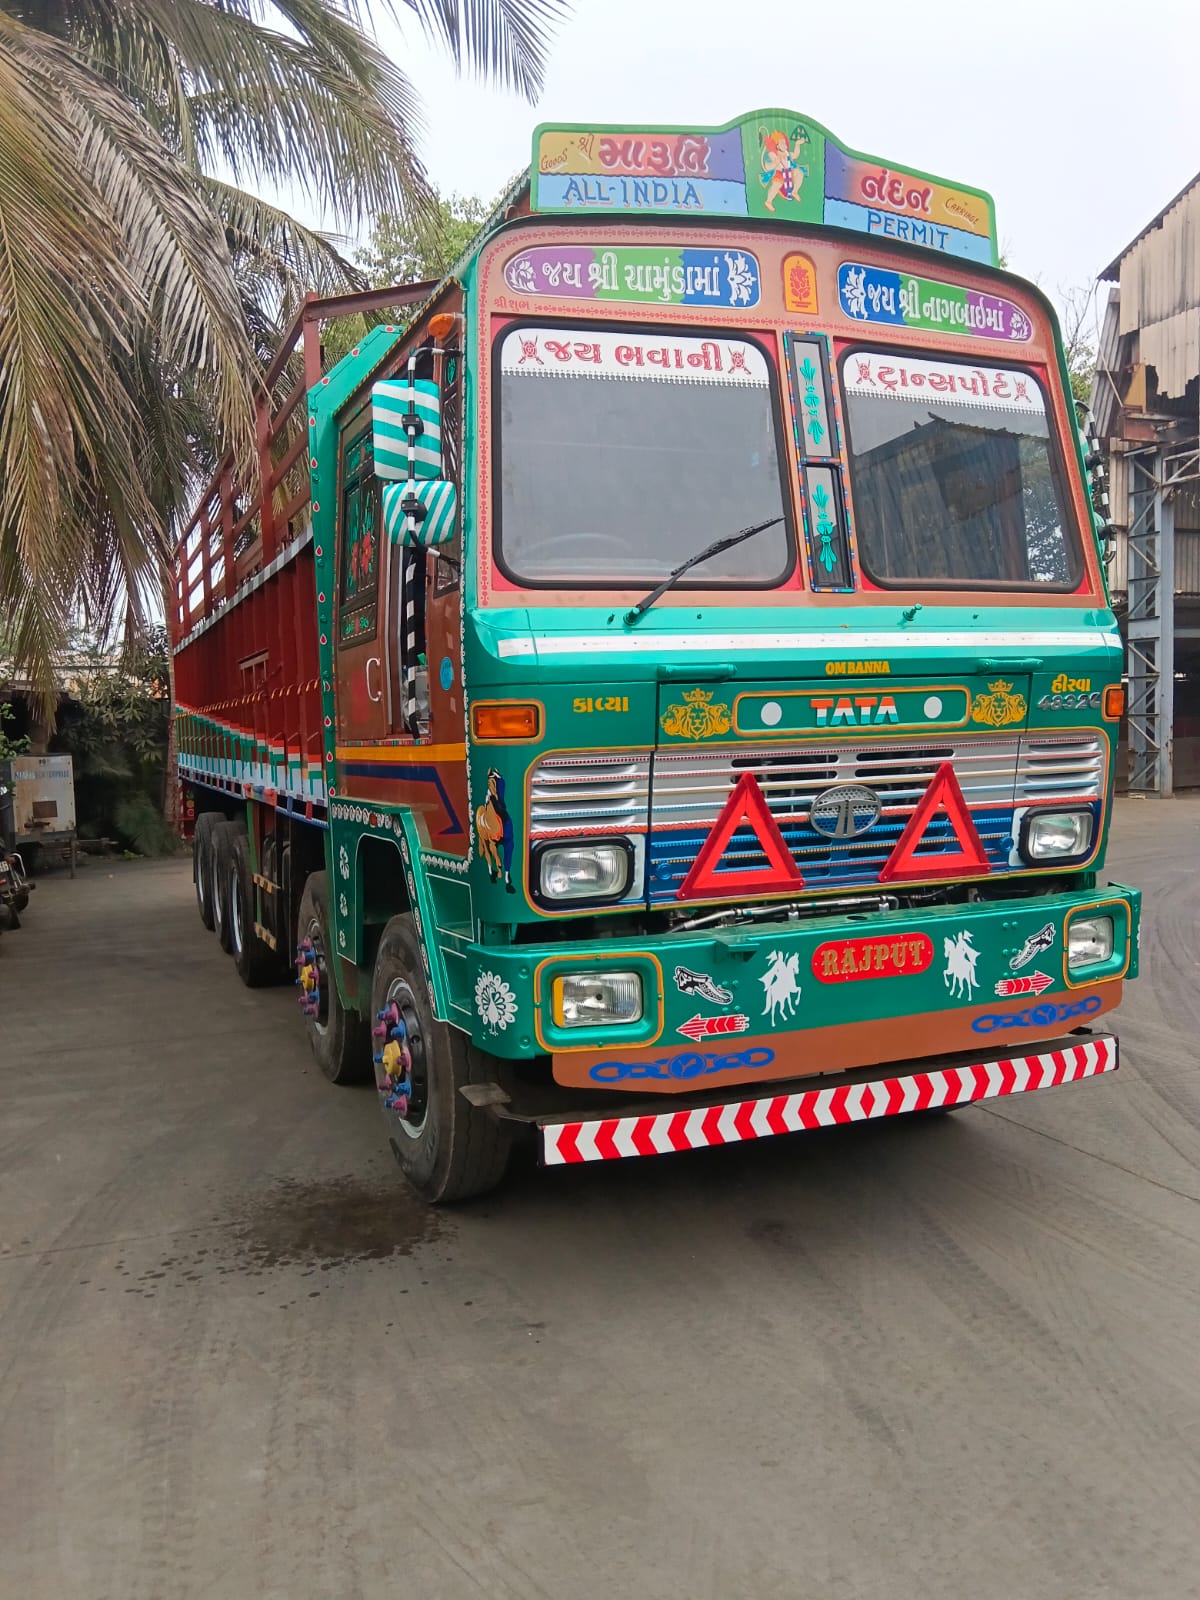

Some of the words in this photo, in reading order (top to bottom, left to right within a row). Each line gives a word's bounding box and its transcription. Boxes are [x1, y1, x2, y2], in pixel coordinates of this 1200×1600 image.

[861, 169, 932, 214] નંદન
[561, 177, 703, 208] ALL-INDIA
[866, 210, 949, 250] PERMIT
[541, 261, 583, 289] જય
[588, 251, 620, 291] શ્રી
[867, 283, 896, 316] જય
[899, 279, 921, 319] શ્રી
[544, 340, 603, 364] જય
[614, 341, 723, 372] ભવાની
[877, 366, 1012, 399] ટ્રાન્સપોર્ટ
[825, 661, 847, 676] OM
[848, 660, 891, 675] BANNA
[573, 696, 630, 714] કાવ્યા
[810, 696, 900, 727] TATA
[820, 939, 926, 977] RAJPUT
